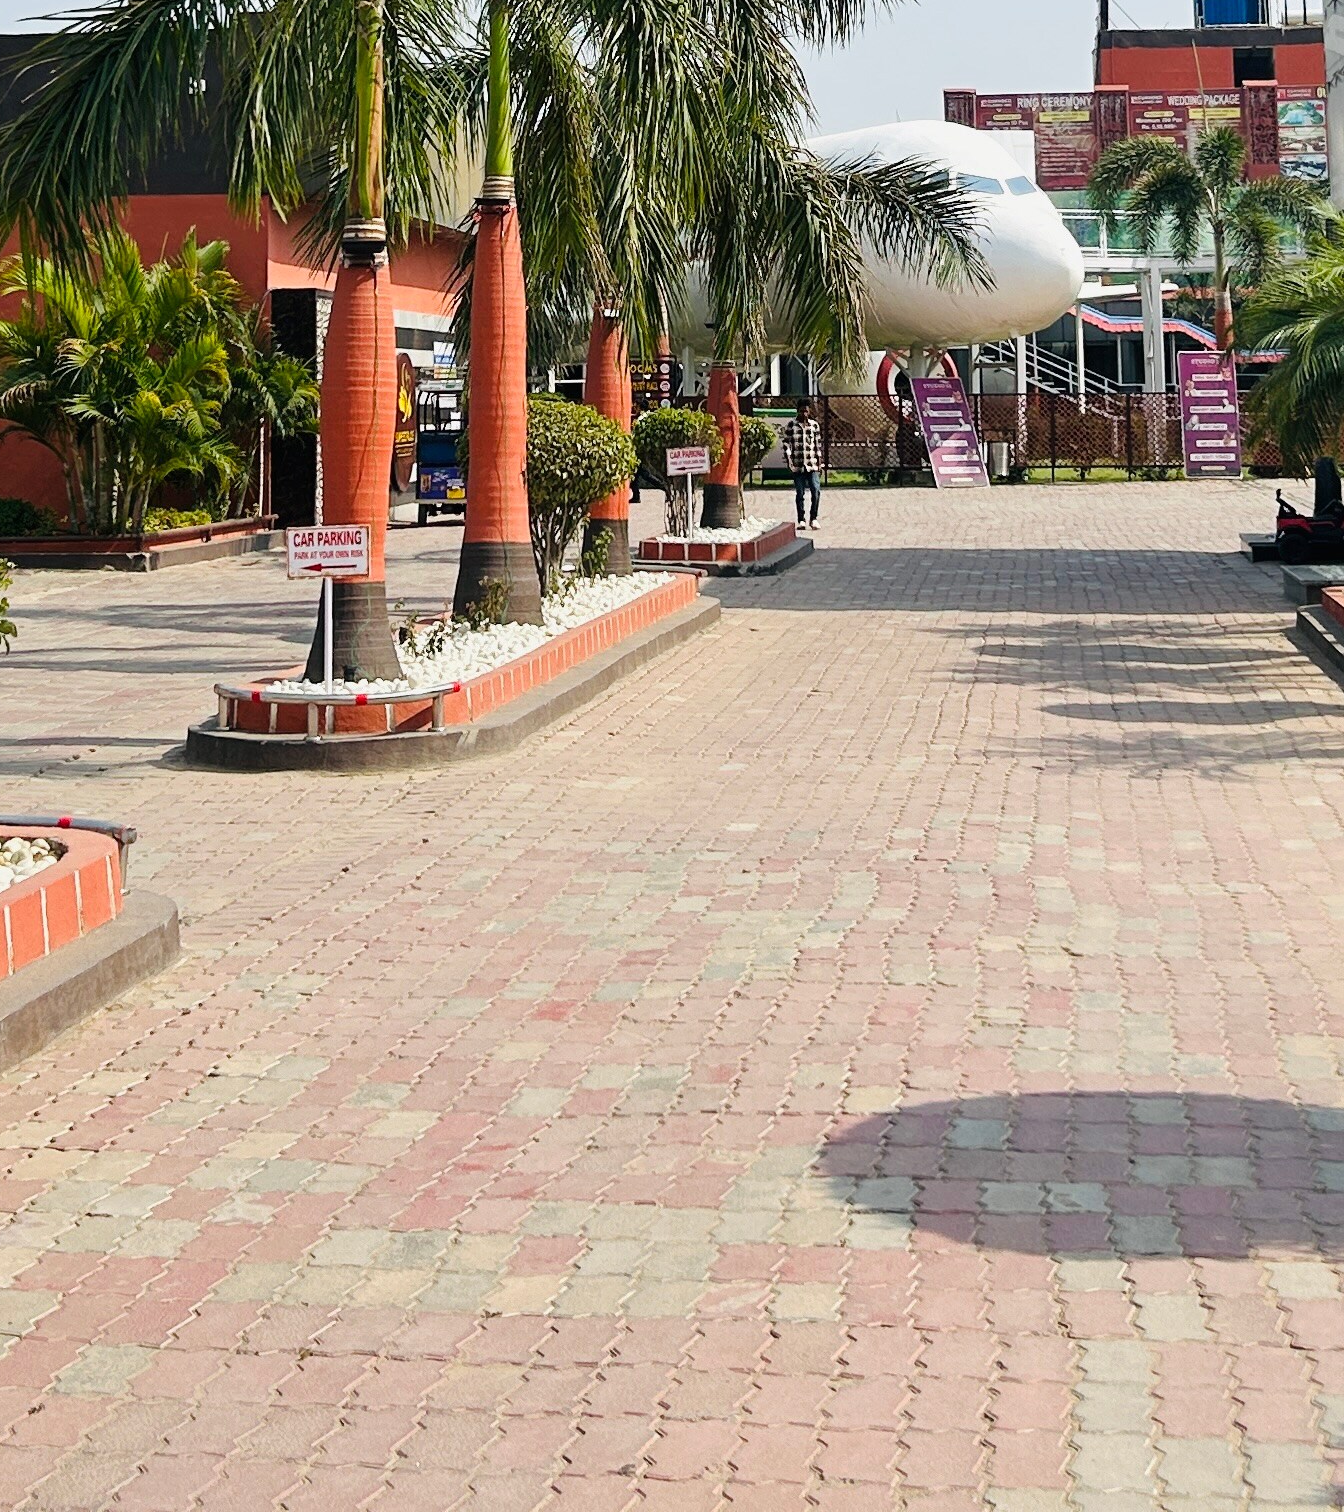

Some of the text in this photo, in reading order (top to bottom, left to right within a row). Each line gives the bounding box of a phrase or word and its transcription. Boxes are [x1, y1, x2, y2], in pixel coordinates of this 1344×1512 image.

[1017, 97, 1039, 108] RING
[1041, 95, 1093, 108] CEREMONY
[1167, 95, 1203, 106] WEDDING
[1203, 93, 1241, 106] PACKAGE
[293, 530, 362, 547] CAR PARKING
